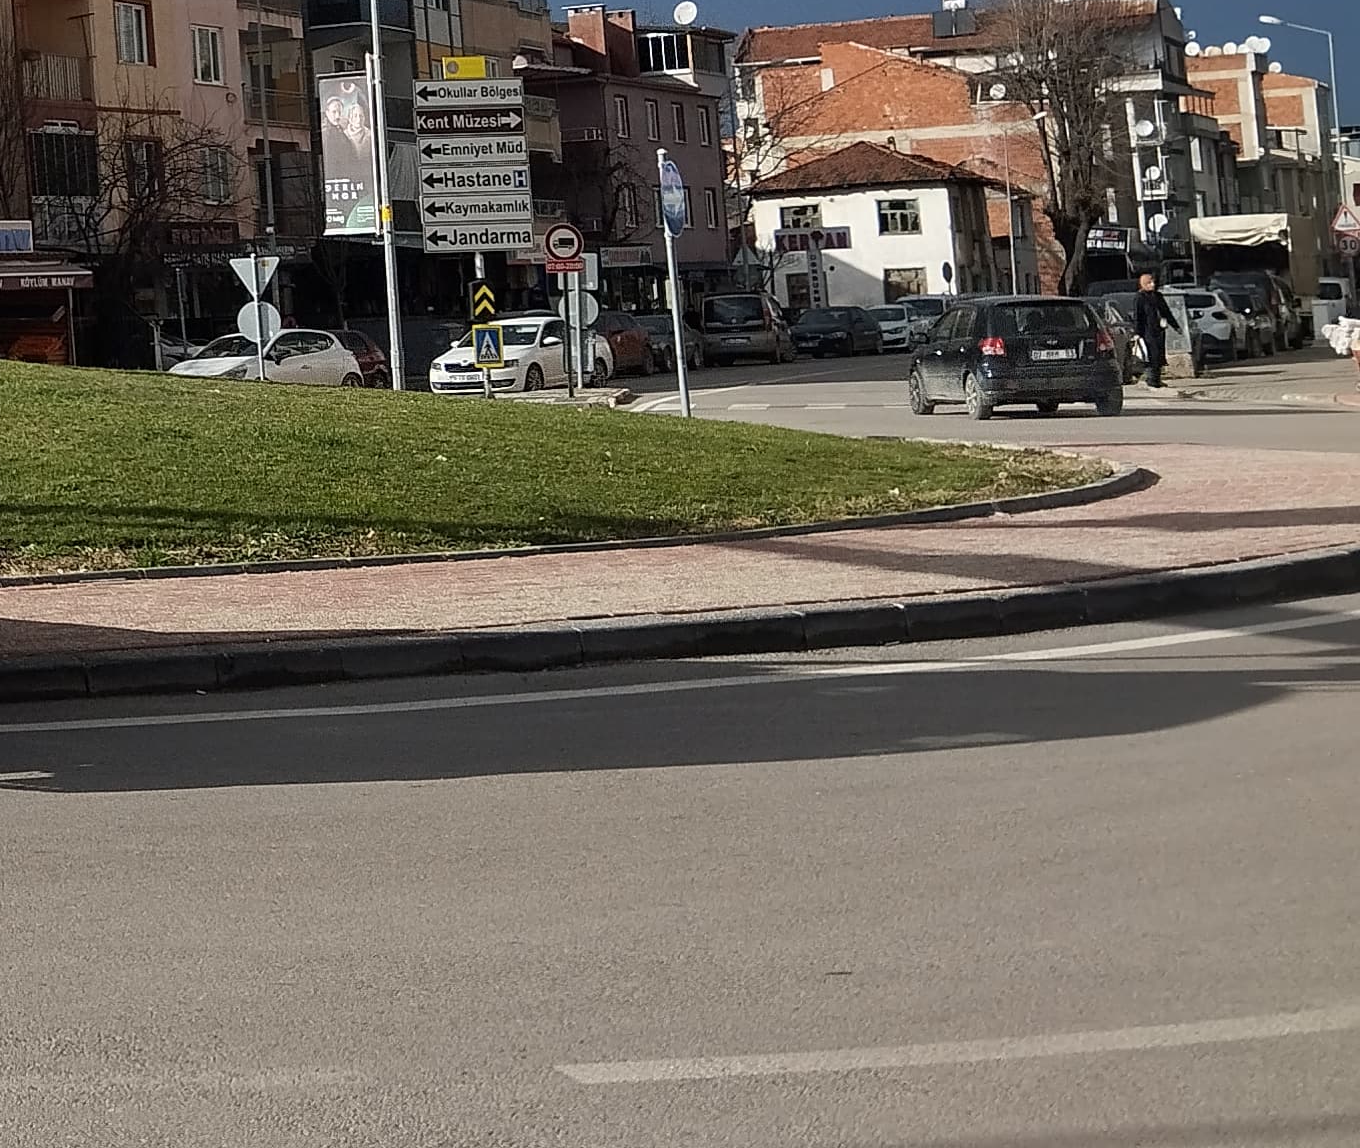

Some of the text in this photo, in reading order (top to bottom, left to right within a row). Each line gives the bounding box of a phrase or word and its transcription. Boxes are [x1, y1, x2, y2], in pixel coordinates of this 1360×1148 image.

[438, 85, 522, 99] Okullar Bölgesi
[417, 113, 501, 129] Kent Müzesi
[442, 141, 528, 158] Emniyet Müd.
[444, 171, 511, 188] Hastane
[445, 200, 529, 216] Kaymakamlık
[448, 228, 531, 246] Jandarma
[1342, 240, 1357, 250] 30
[51, 276, 75, 287] MANAV
